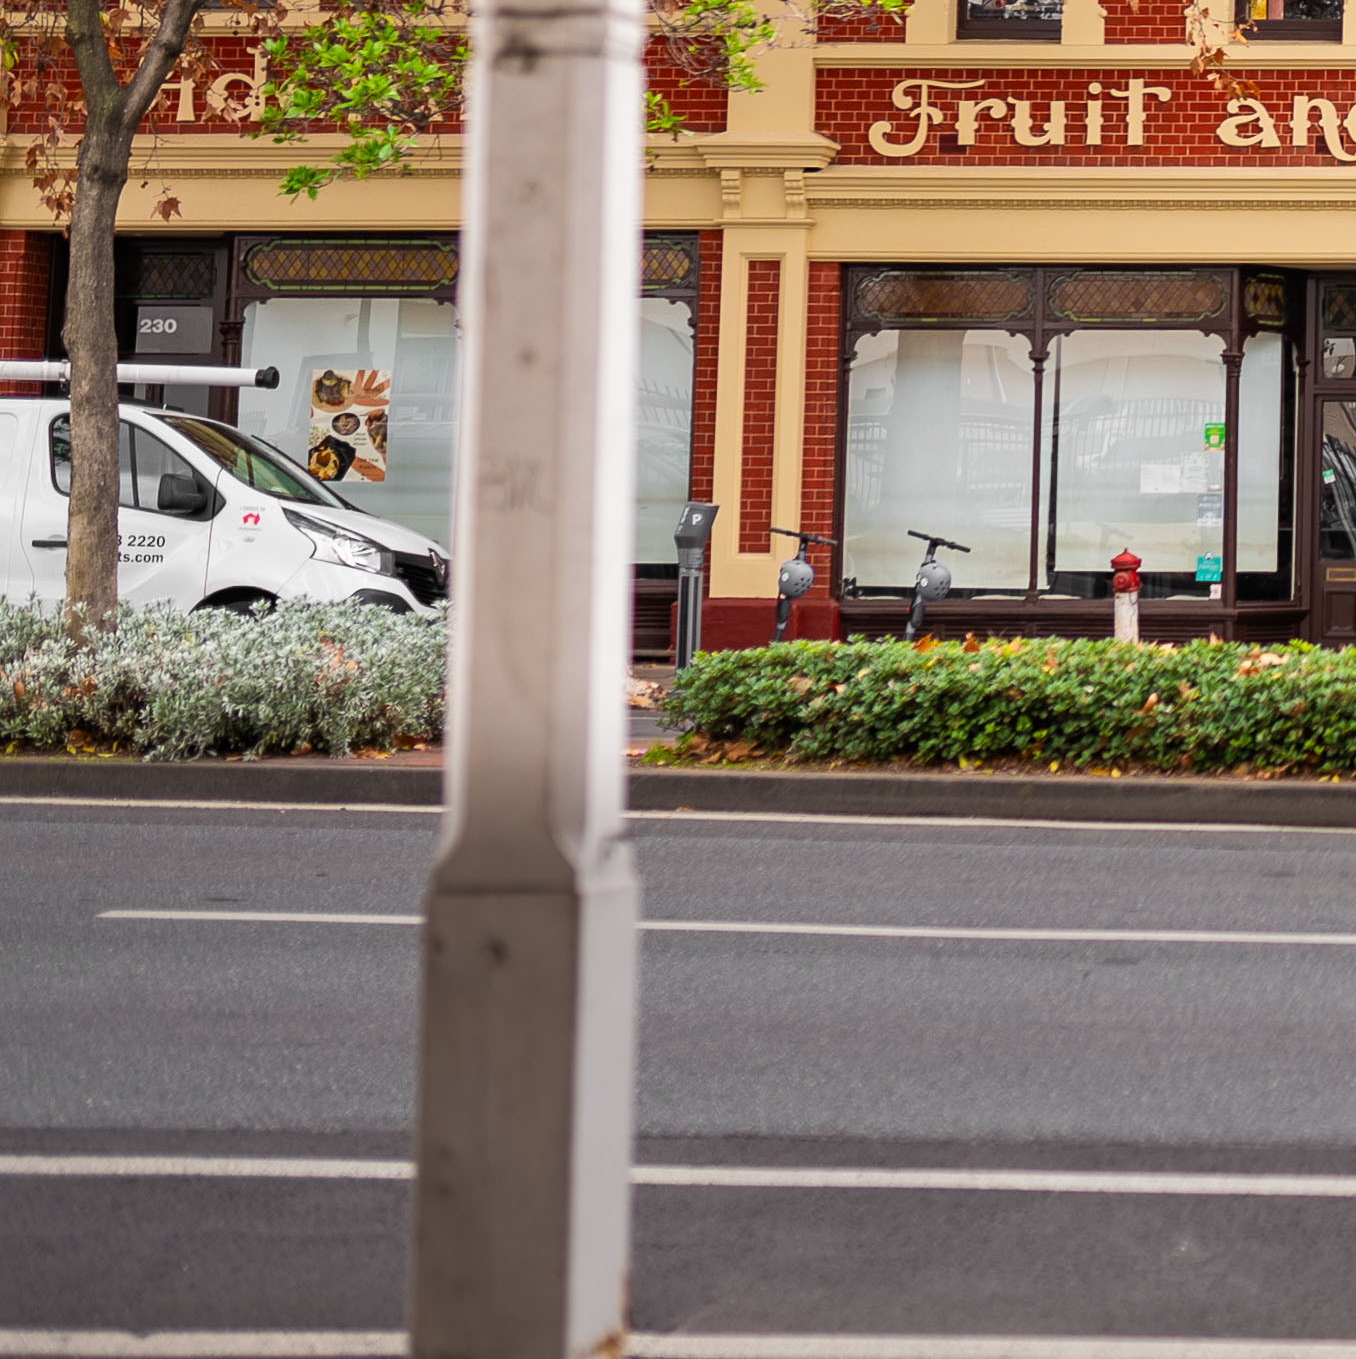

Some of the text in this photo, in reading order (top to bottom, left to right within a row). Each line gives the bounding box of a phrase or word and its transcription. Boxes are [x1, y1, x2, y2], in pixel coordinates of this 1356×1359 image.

[868, 77, 1172, 158] Fruit
[140, 318, 178, 334] 230
[127, 535, 166, 548] 2220
[117, 551, 164, 563] ts.com
